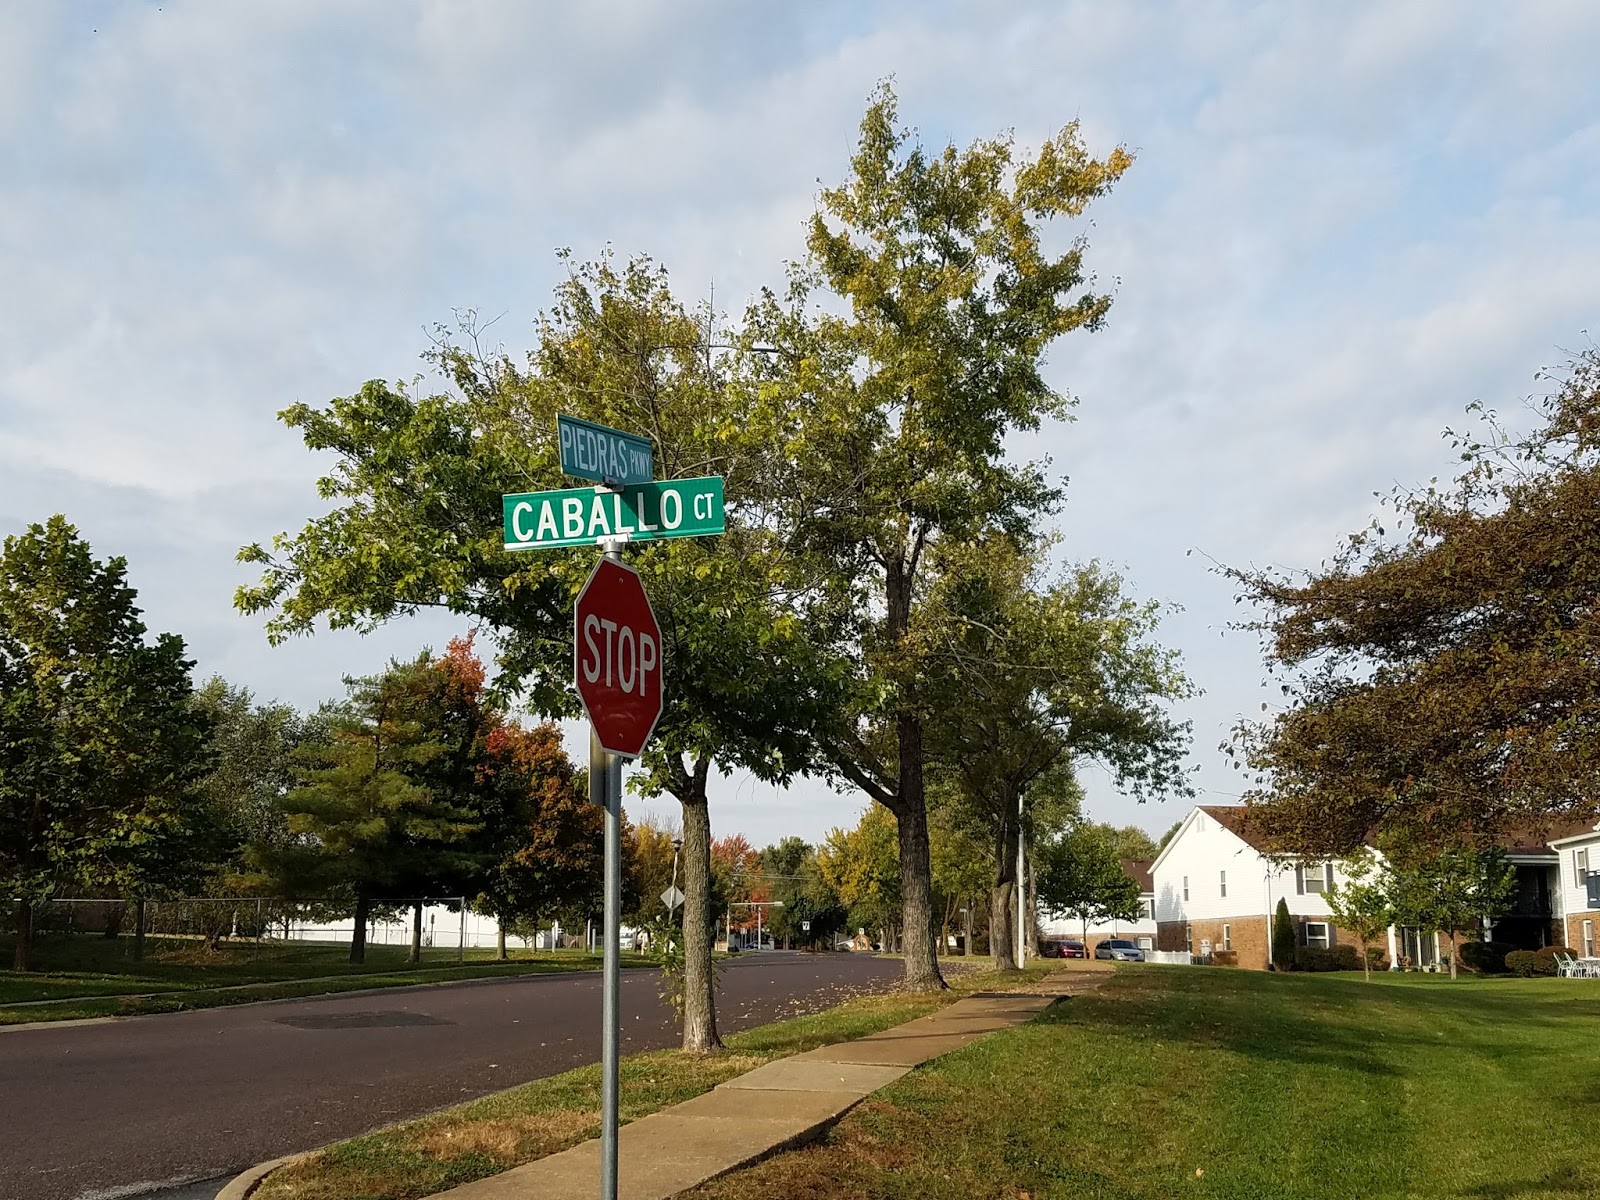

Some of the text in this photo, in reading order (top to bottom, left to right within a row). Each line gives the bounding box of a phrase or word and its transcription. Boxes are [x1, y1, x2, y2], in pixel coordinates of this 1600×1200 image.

[561, 424, 650, 479] PIEDRAS PKWY
[512, 489, 715, 541] CABALLO CT
[582, 613, 656, 697] STOP
